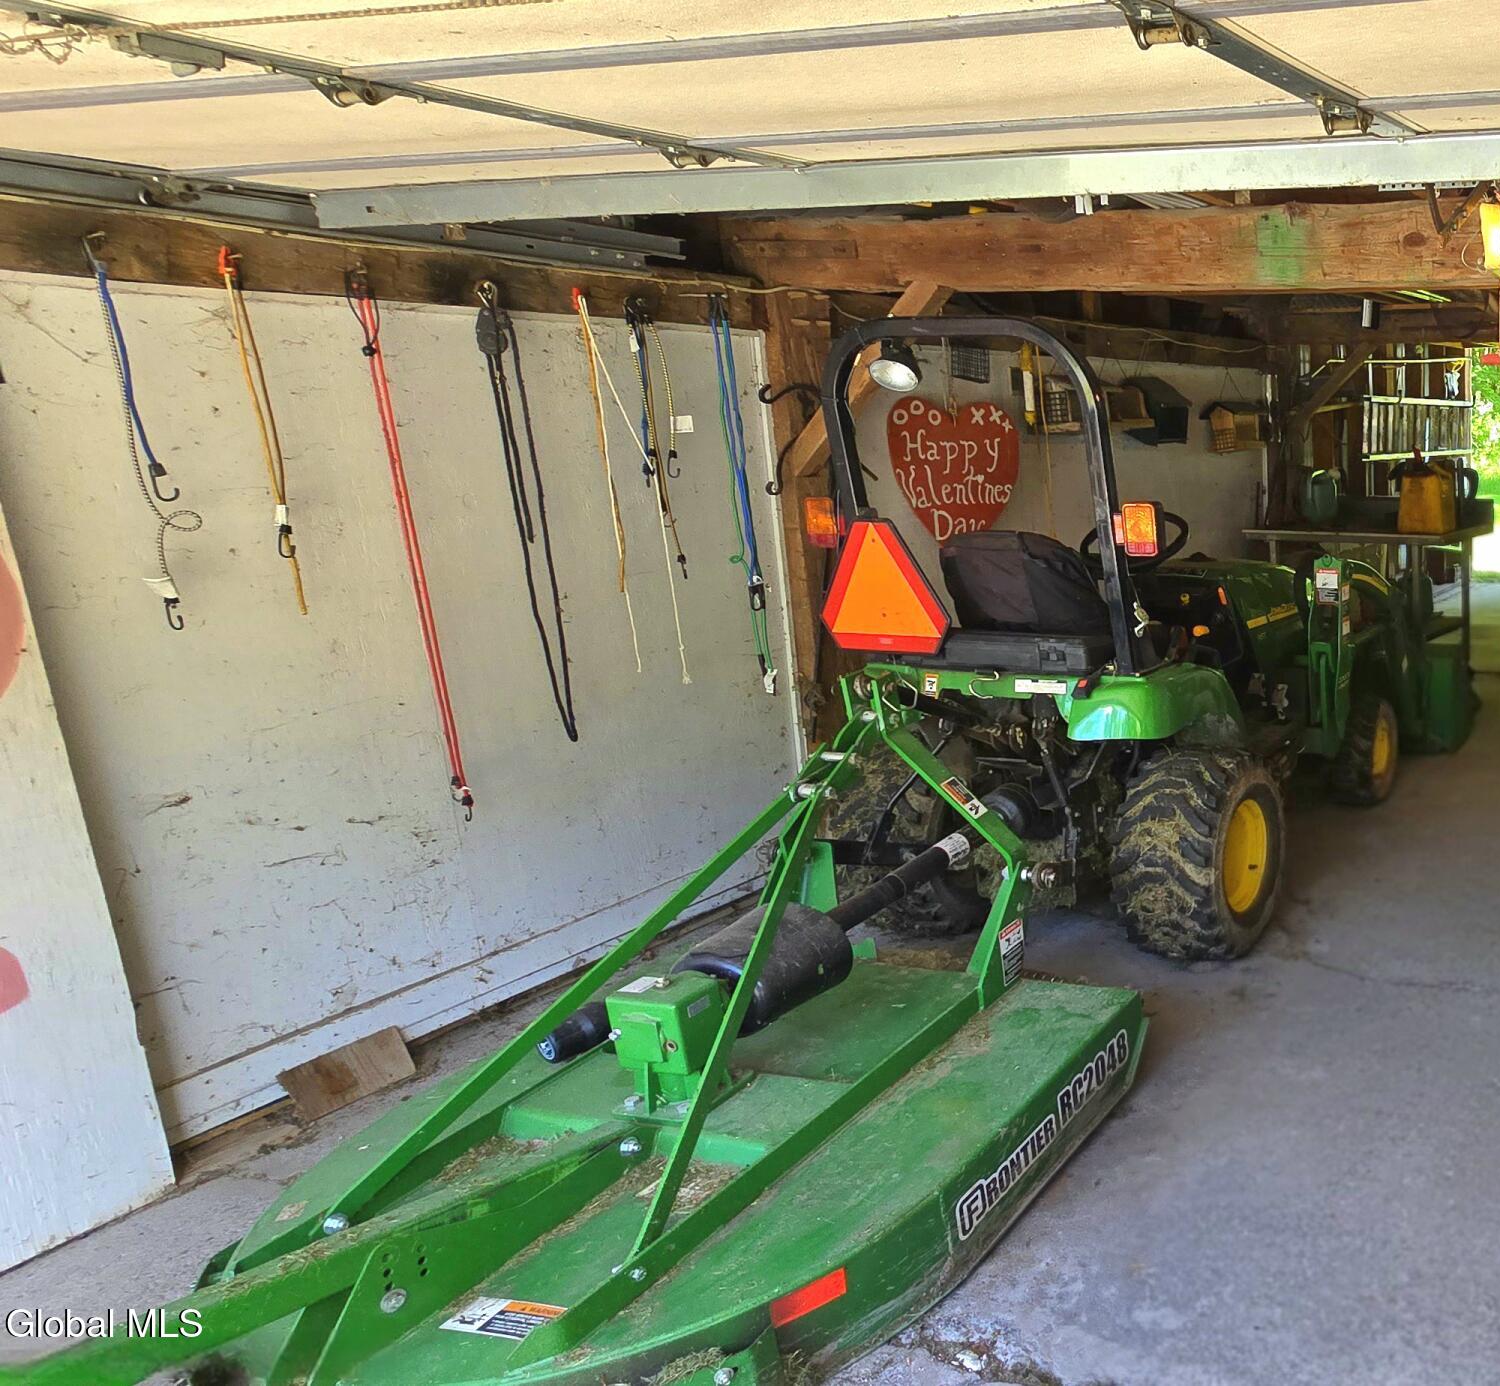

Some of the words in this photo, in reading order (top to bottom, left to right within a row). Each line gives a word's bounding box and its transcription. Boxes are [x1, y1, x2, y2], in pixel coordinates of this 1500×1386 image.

[900, 429, 1001, 475] Happy
[896, 465, 1013, 509] Valentines
[957, 1115, 1057, 1237] FRONTIER
[1058, 1029, 1128, 1126] RC2048
